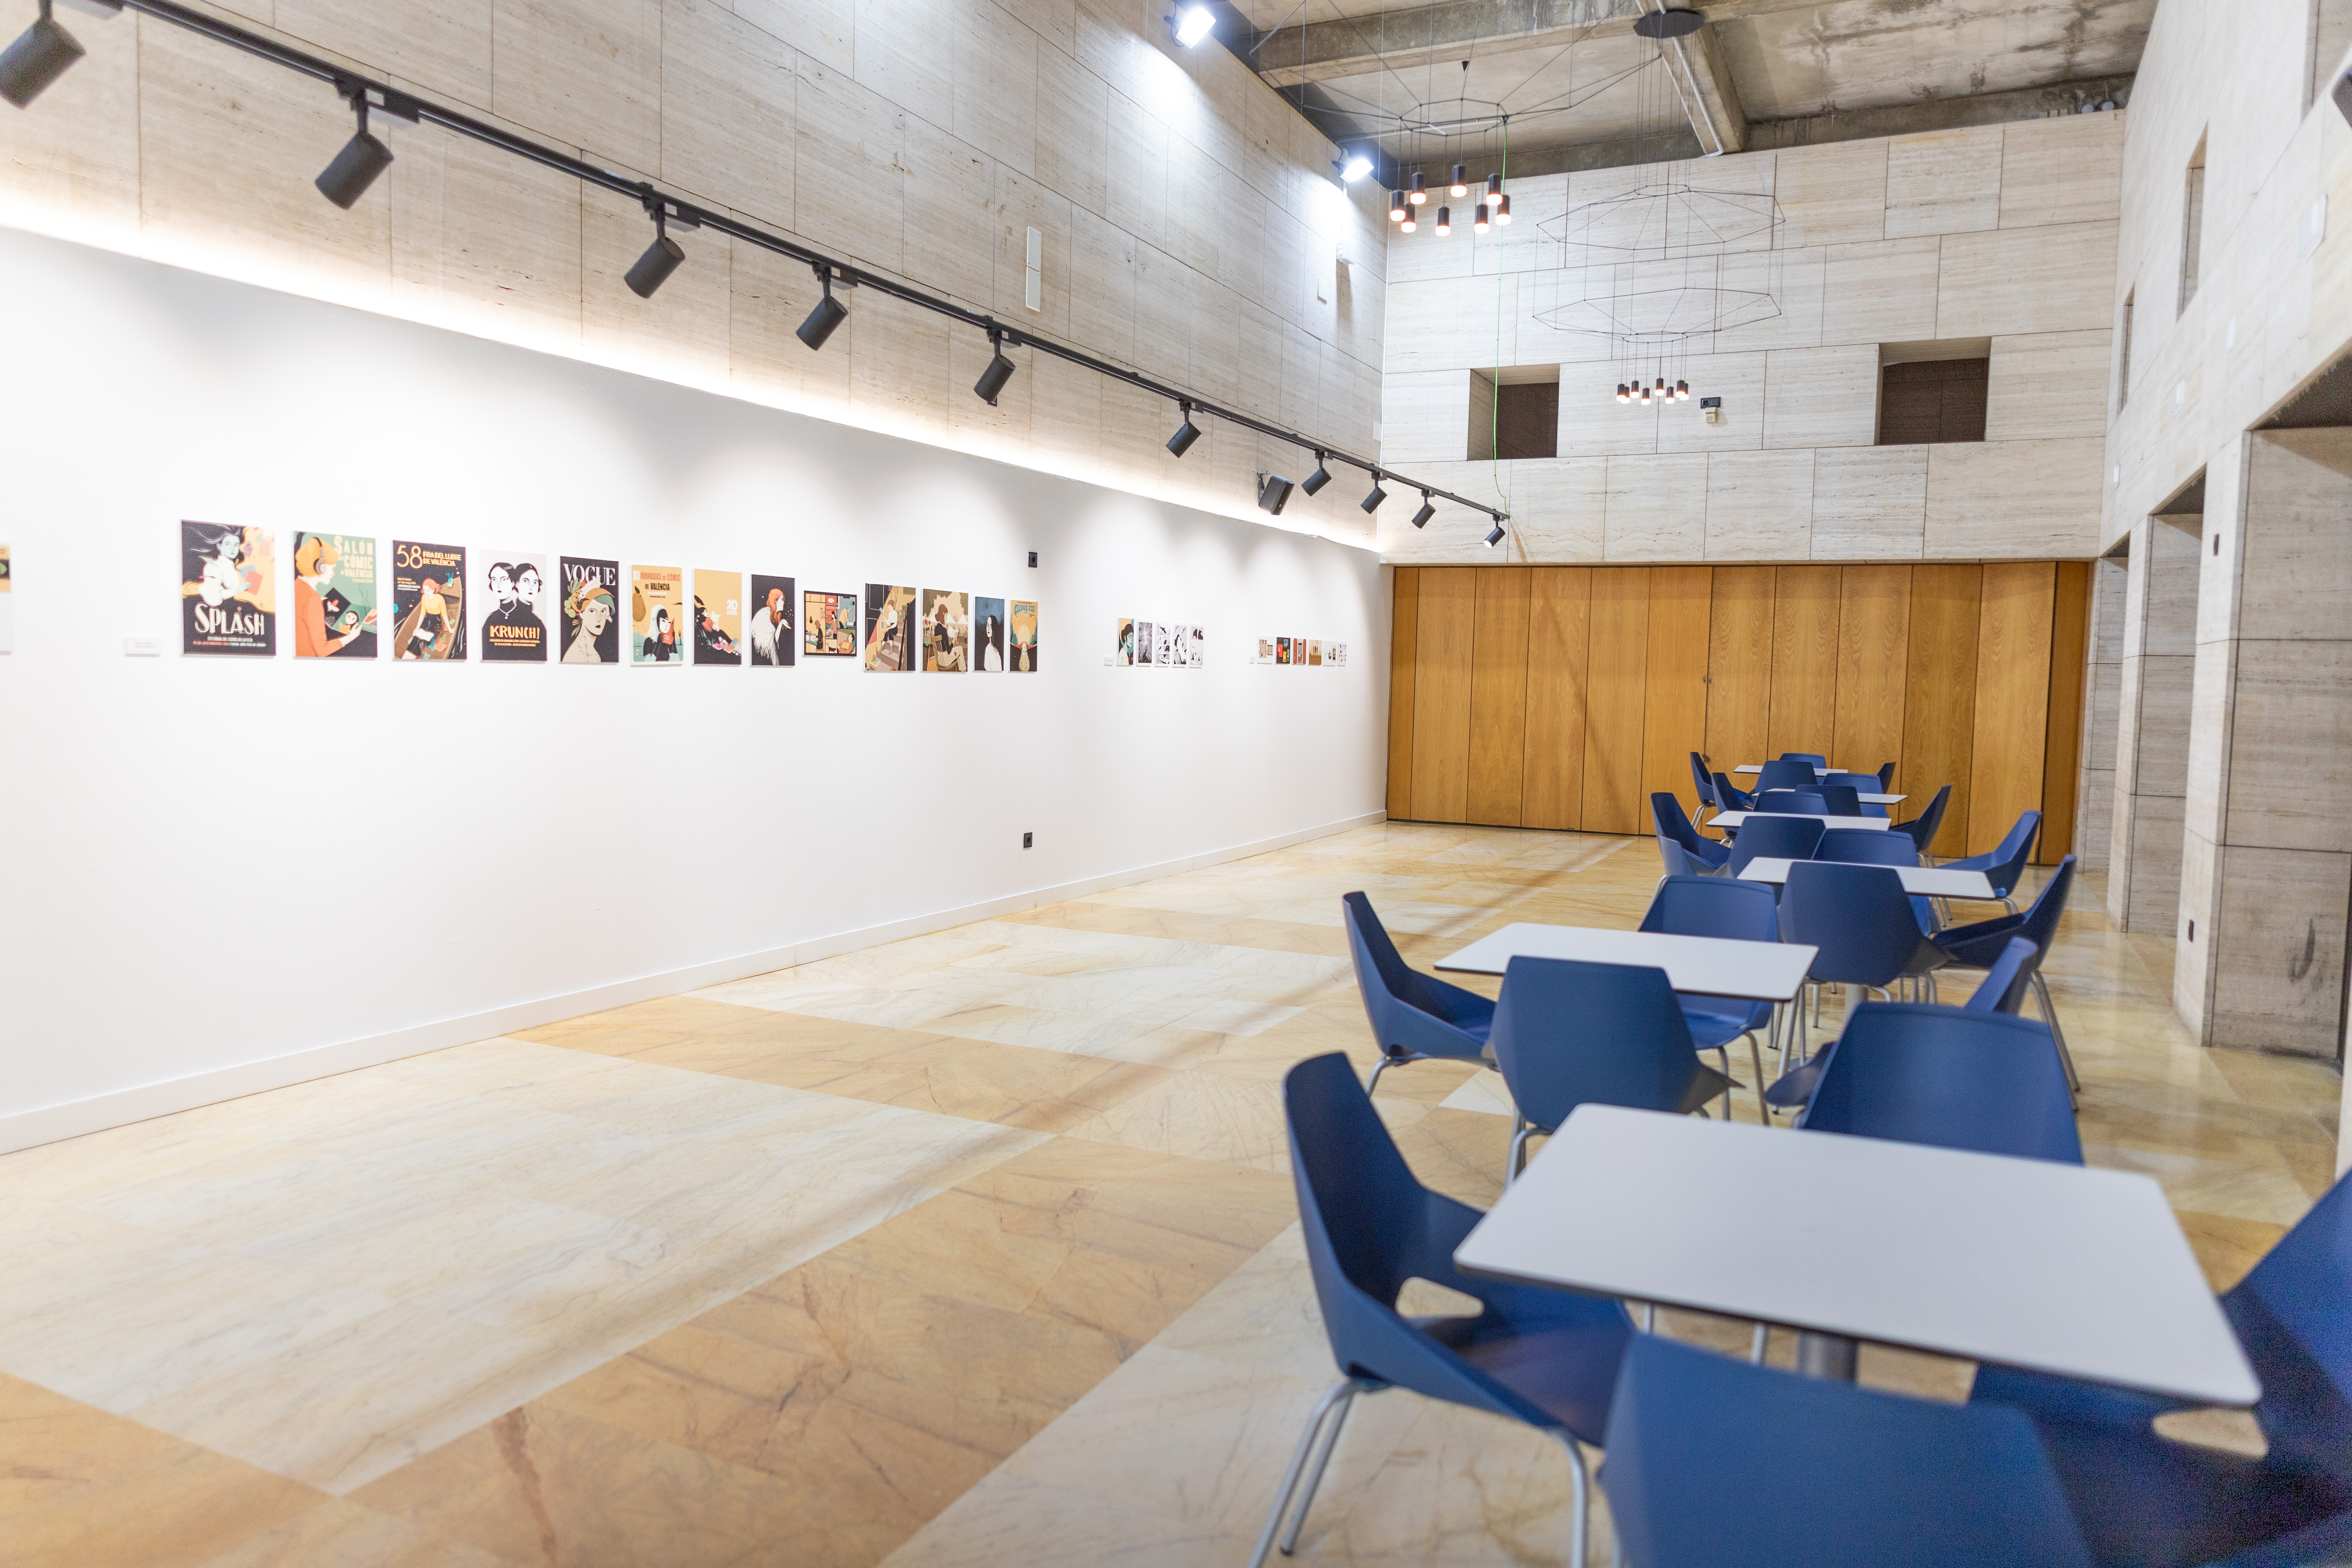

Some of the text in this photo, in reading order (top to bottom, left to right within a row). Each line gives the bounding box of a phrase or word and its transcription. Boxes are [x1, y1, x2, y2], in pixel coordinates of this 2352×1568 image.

[344, 554, 374, 570] CÓMIC
[397, 545, 423, 568] 58
[563, 564, 616, 586] VOGUE
[633, 570, 640, 581] XI
[640, 572, 662, 580] JORNADAS
[650, 582, 670, 591] VALÈNCIA
[726, 599, 738, 611] 20
[1014, 604, 1027, 616] CELSIUS
[194, 603, 265, 635] SPLASH
[490, 625, 540, 639] KRUNCH!
